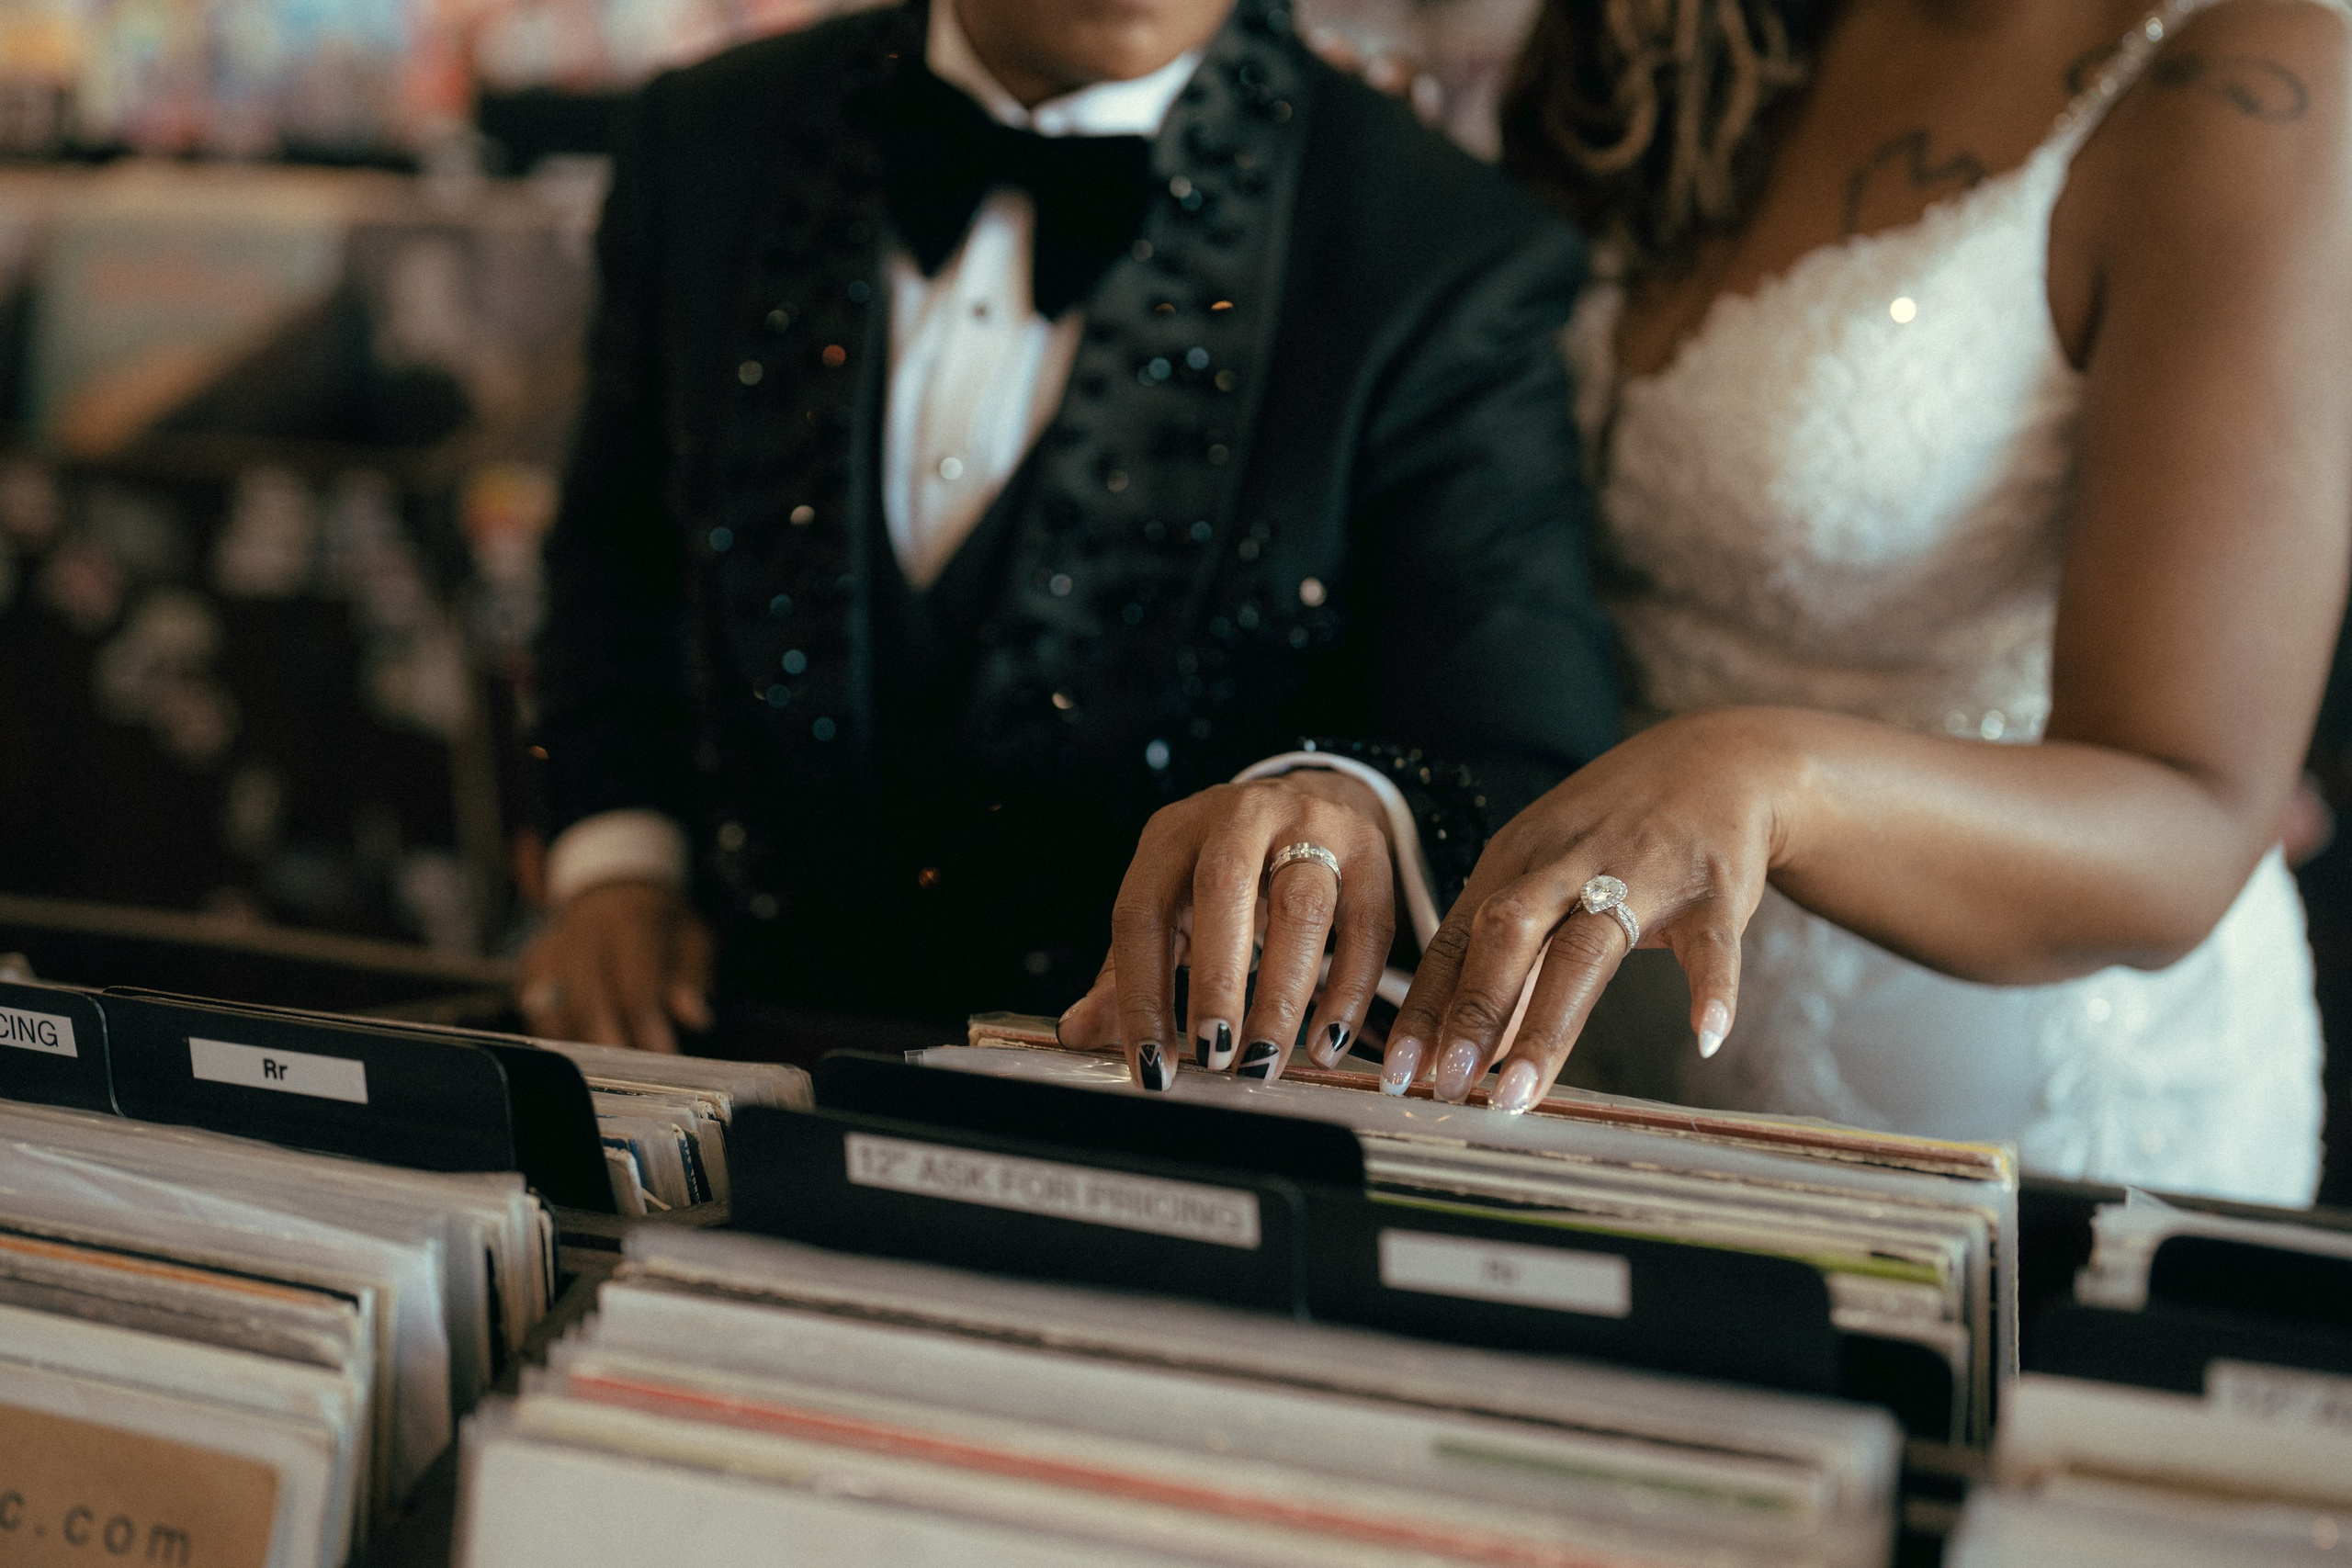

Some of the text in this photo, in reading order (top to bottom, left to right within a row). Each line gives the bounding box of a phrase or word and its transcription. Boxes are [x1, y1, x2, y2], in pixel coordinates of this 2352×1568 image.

[263, 1058, 288, 1081] Rr
[919, 1155, 989, 1191] ASK
[1002, 1168, 1081, 1205] FOR
[1091, 1179, 1248, 1234] PRICING
